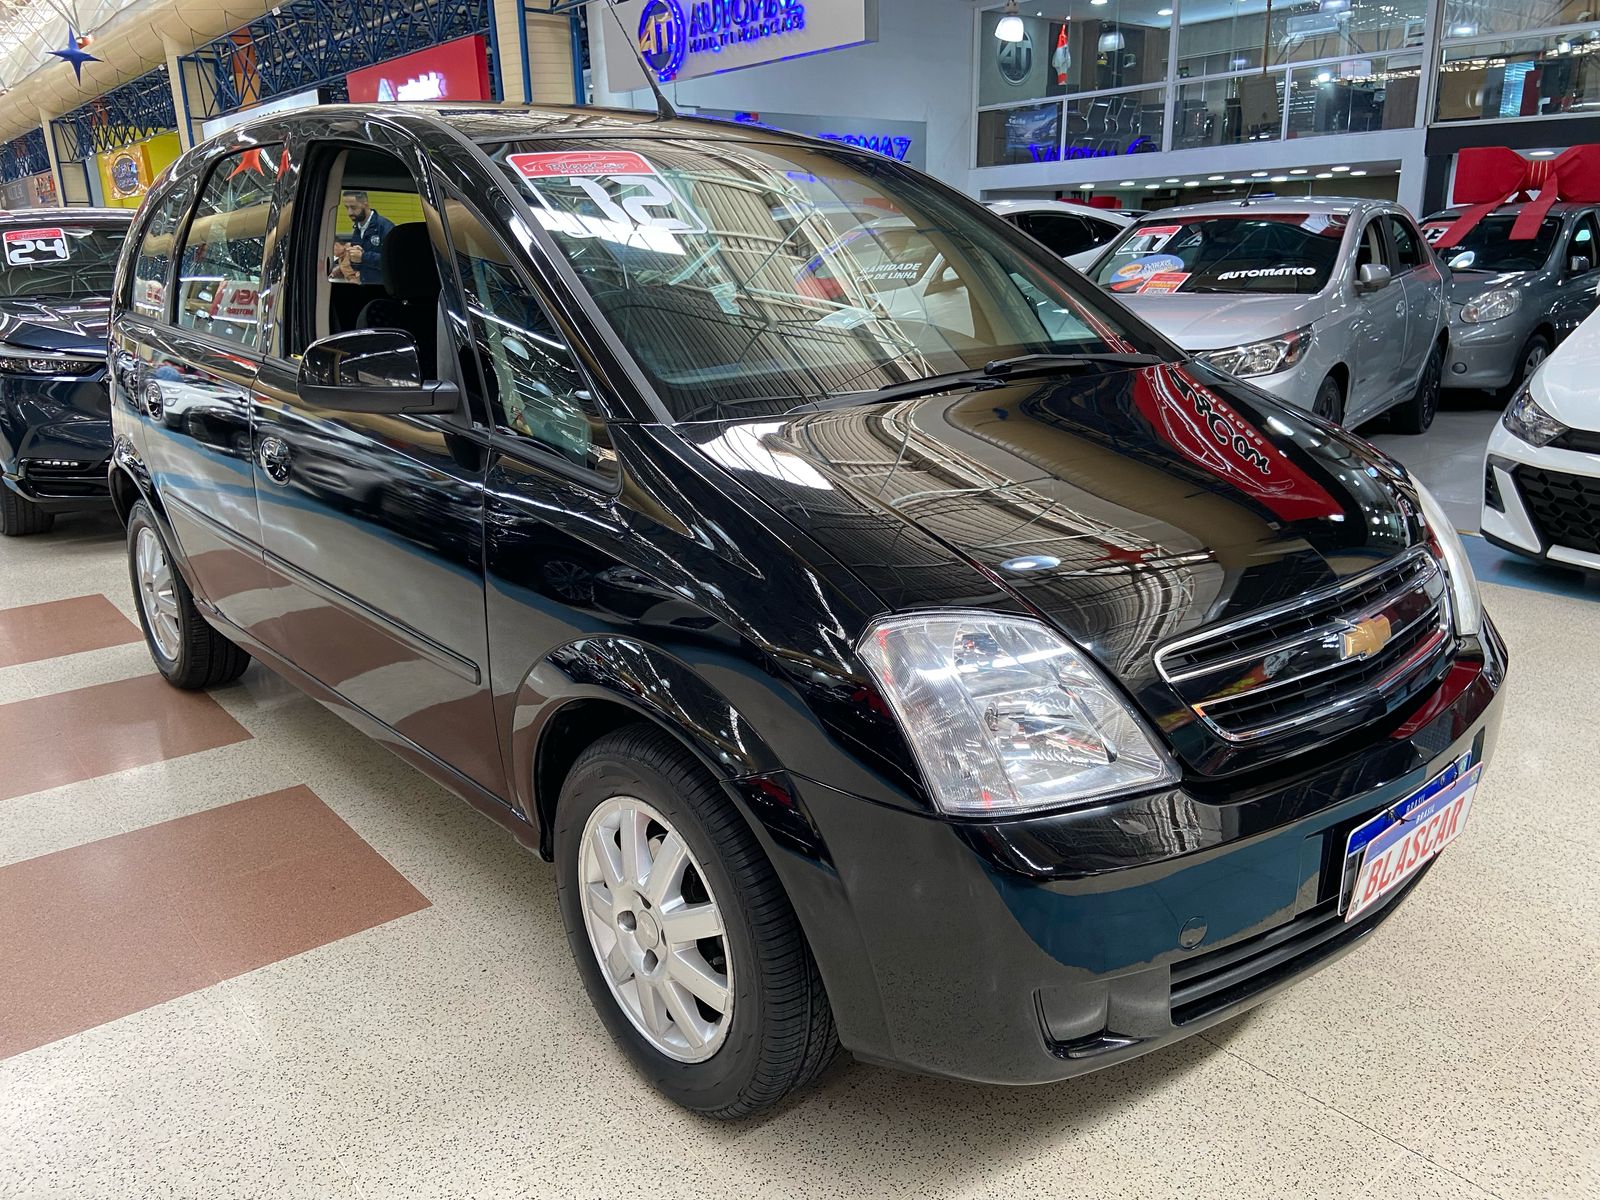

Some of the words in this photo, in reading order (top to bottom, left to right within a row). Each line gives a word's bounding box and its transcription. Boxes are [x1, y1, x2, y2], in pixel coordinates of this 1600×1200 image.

[689, 15, 803, 53] MULTIMARCAS
[569, 175, 693, 231] 12
[10, 239, 66, 263] 24
[874, 272, 888, 280] DE
[888, 271, 917, 279] LINHA
[1415, 805, 1436, 825] BRASIL
[1361, 796, 1465, 903] BLASCAR
